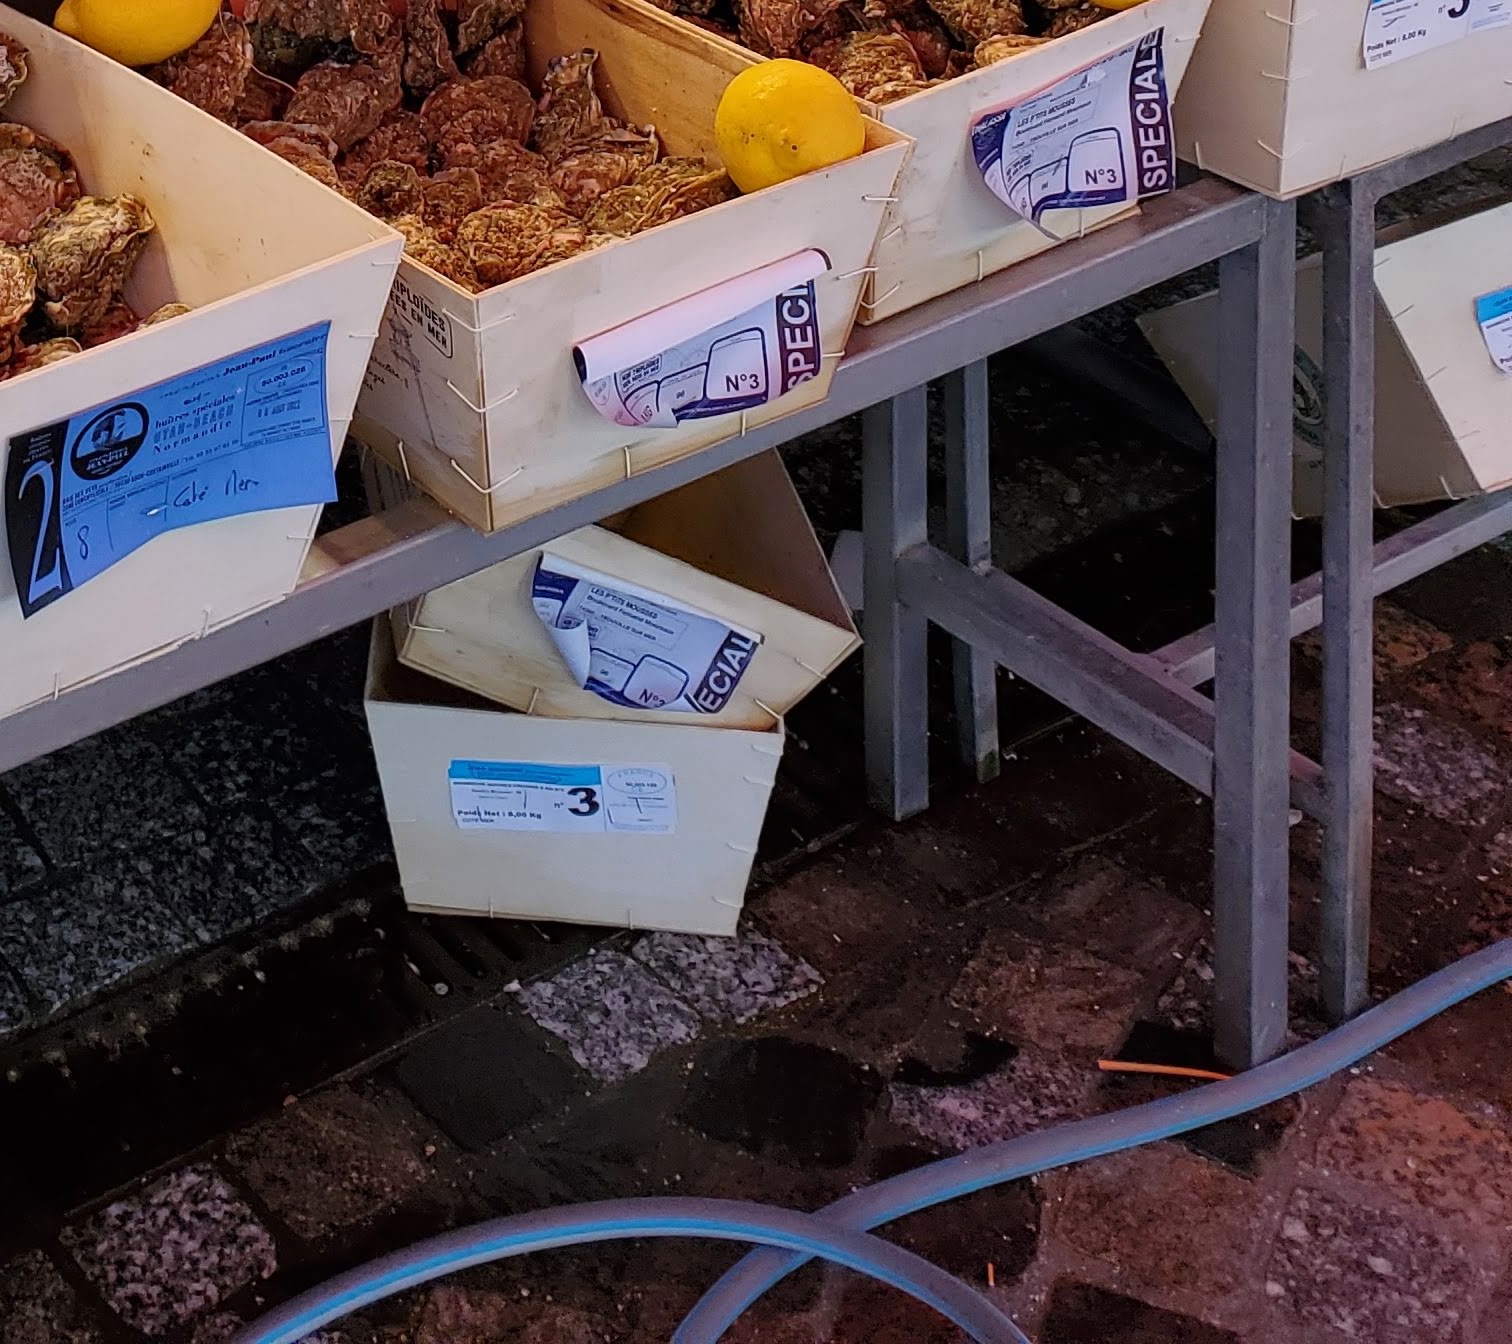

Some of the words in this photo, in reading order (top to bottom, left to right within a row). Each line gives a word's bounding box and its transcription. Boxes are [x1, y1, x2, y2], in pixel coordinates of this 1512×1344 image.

[1084, 168, 1117, 186] N°3
[725, 373, 761, 394] N°3
[17, 459, 63, 606] 2
[567, 786, 600, 817] 3
